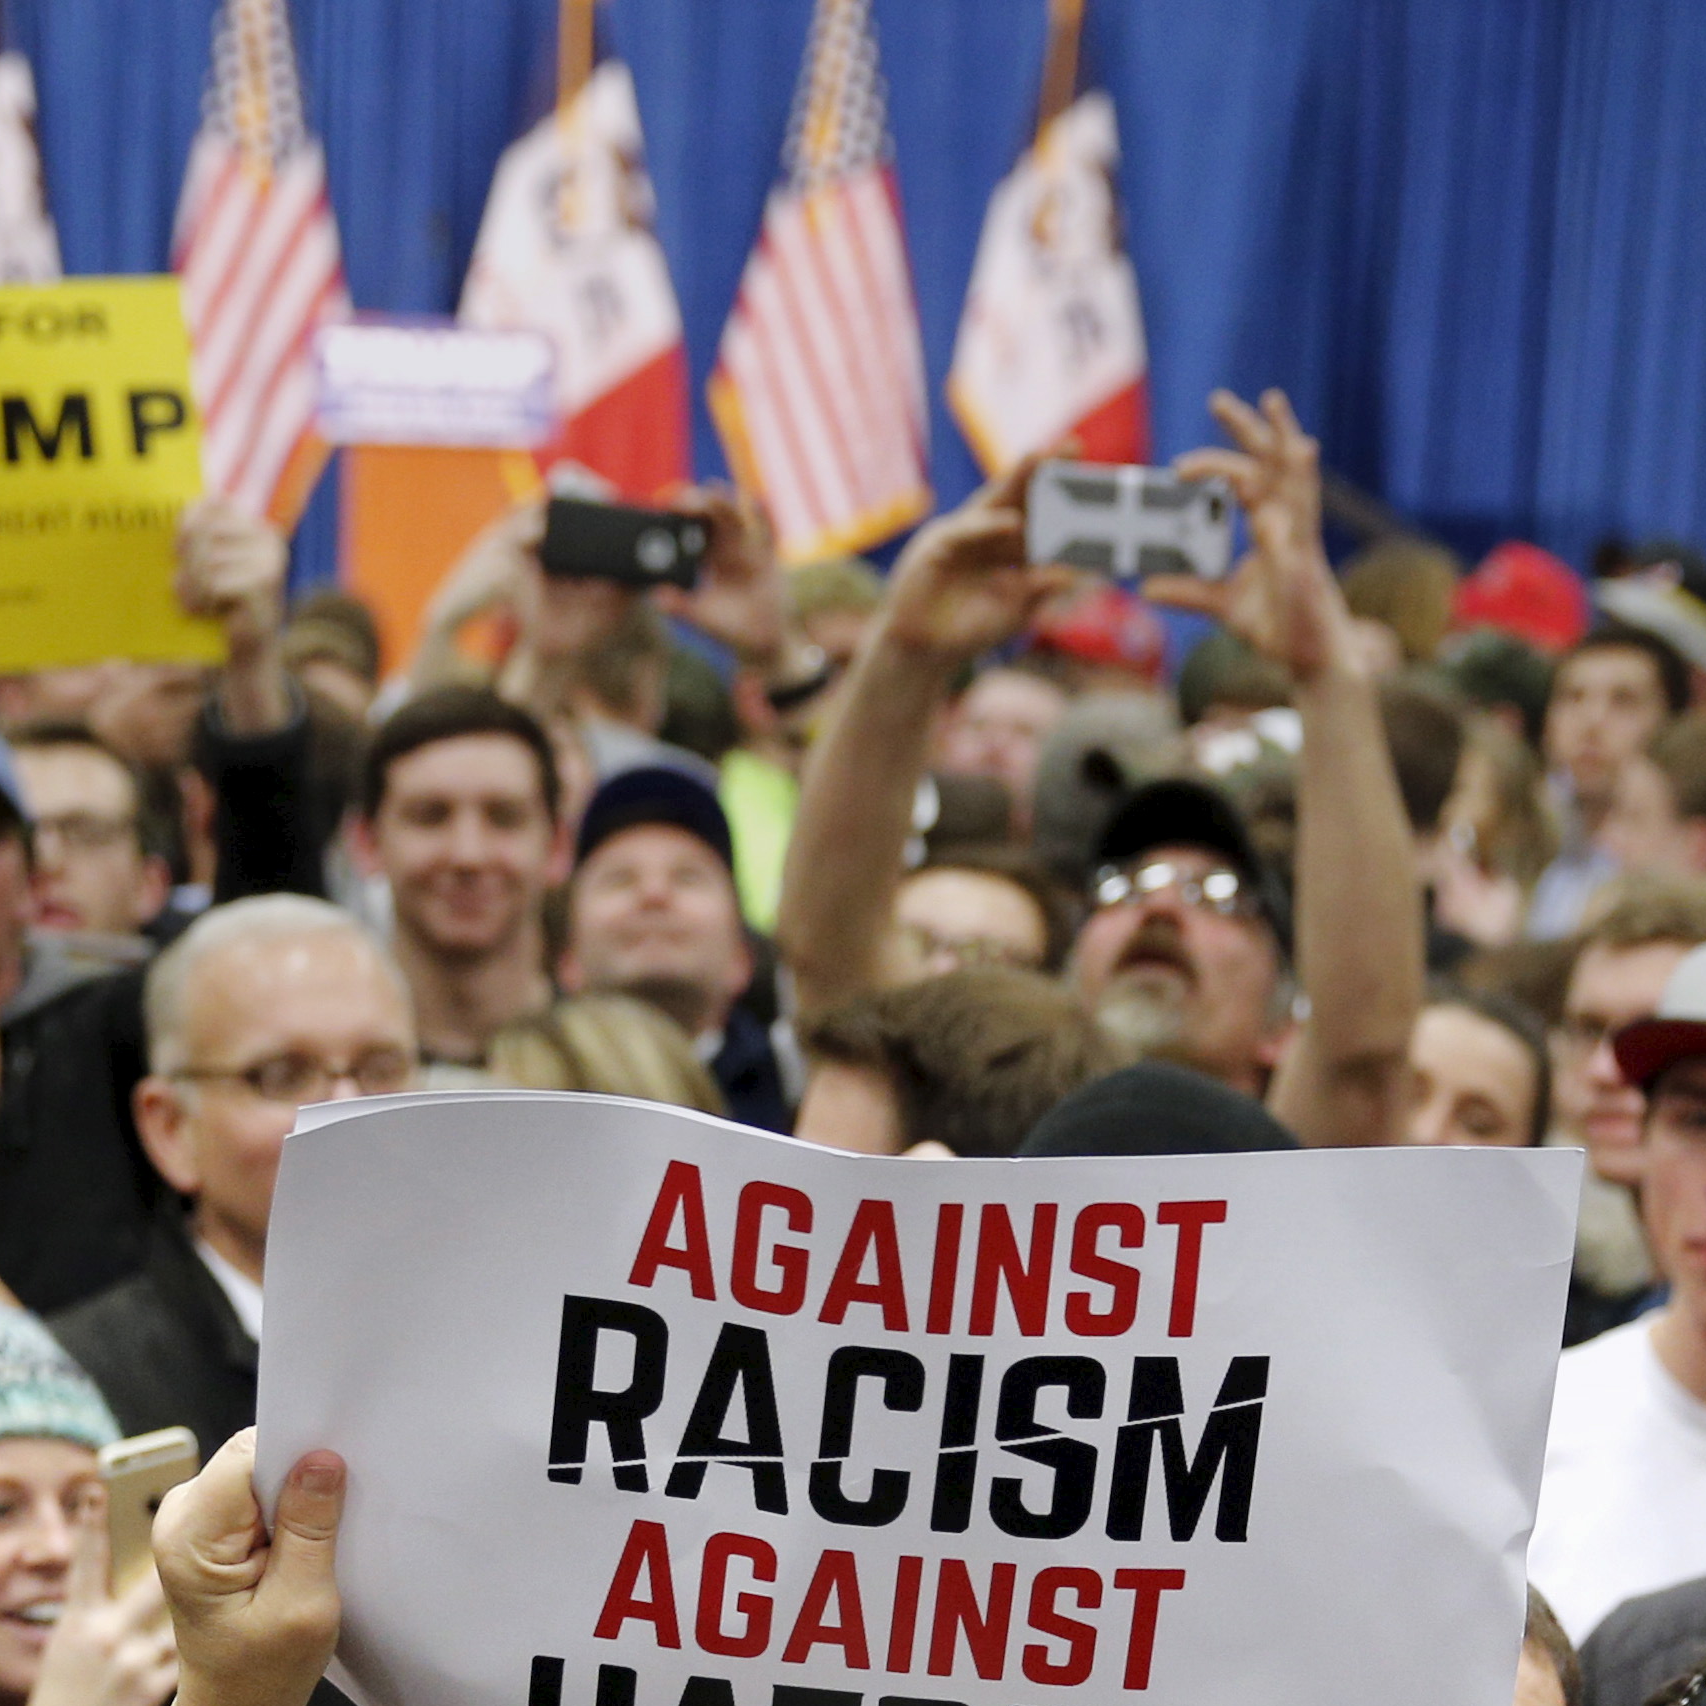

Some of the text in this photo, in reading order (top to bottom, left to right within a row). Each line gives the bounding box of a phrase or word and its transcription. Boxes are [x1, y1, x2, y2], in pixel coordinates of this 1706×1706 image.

[629, 1160, 1227, 1337] AGAINST
[547, 1294, 1271, 1543] RACISM
[594, 1520, 1185, 1690] AGAINST
